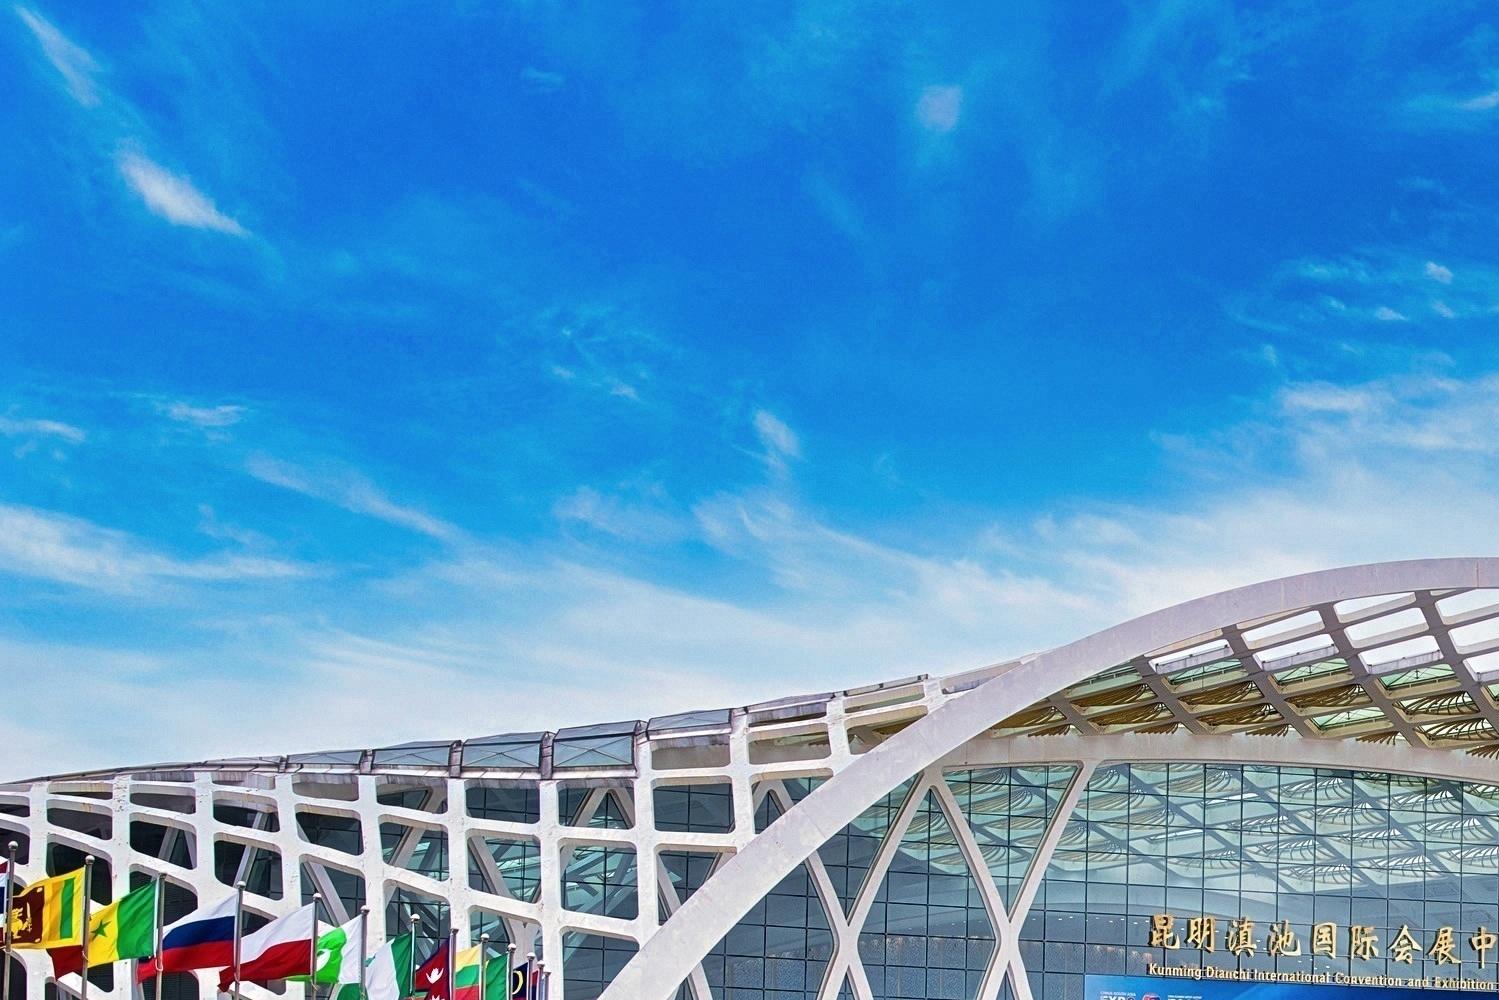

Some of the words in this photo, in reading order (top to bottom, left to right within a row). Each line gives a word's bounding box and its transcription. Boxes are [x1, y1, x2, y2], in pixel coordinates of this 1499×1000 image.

[1149, 963, 1202, 981] Kunming
[1206, 966, 1250, 981] Dianchi
[1253, 969, 1330, 984] International
[1334, 972, 1402, 987] Convention
[1407, 976, 1429, 988] and
[1434, 977, 1494, 991] Exhibition
